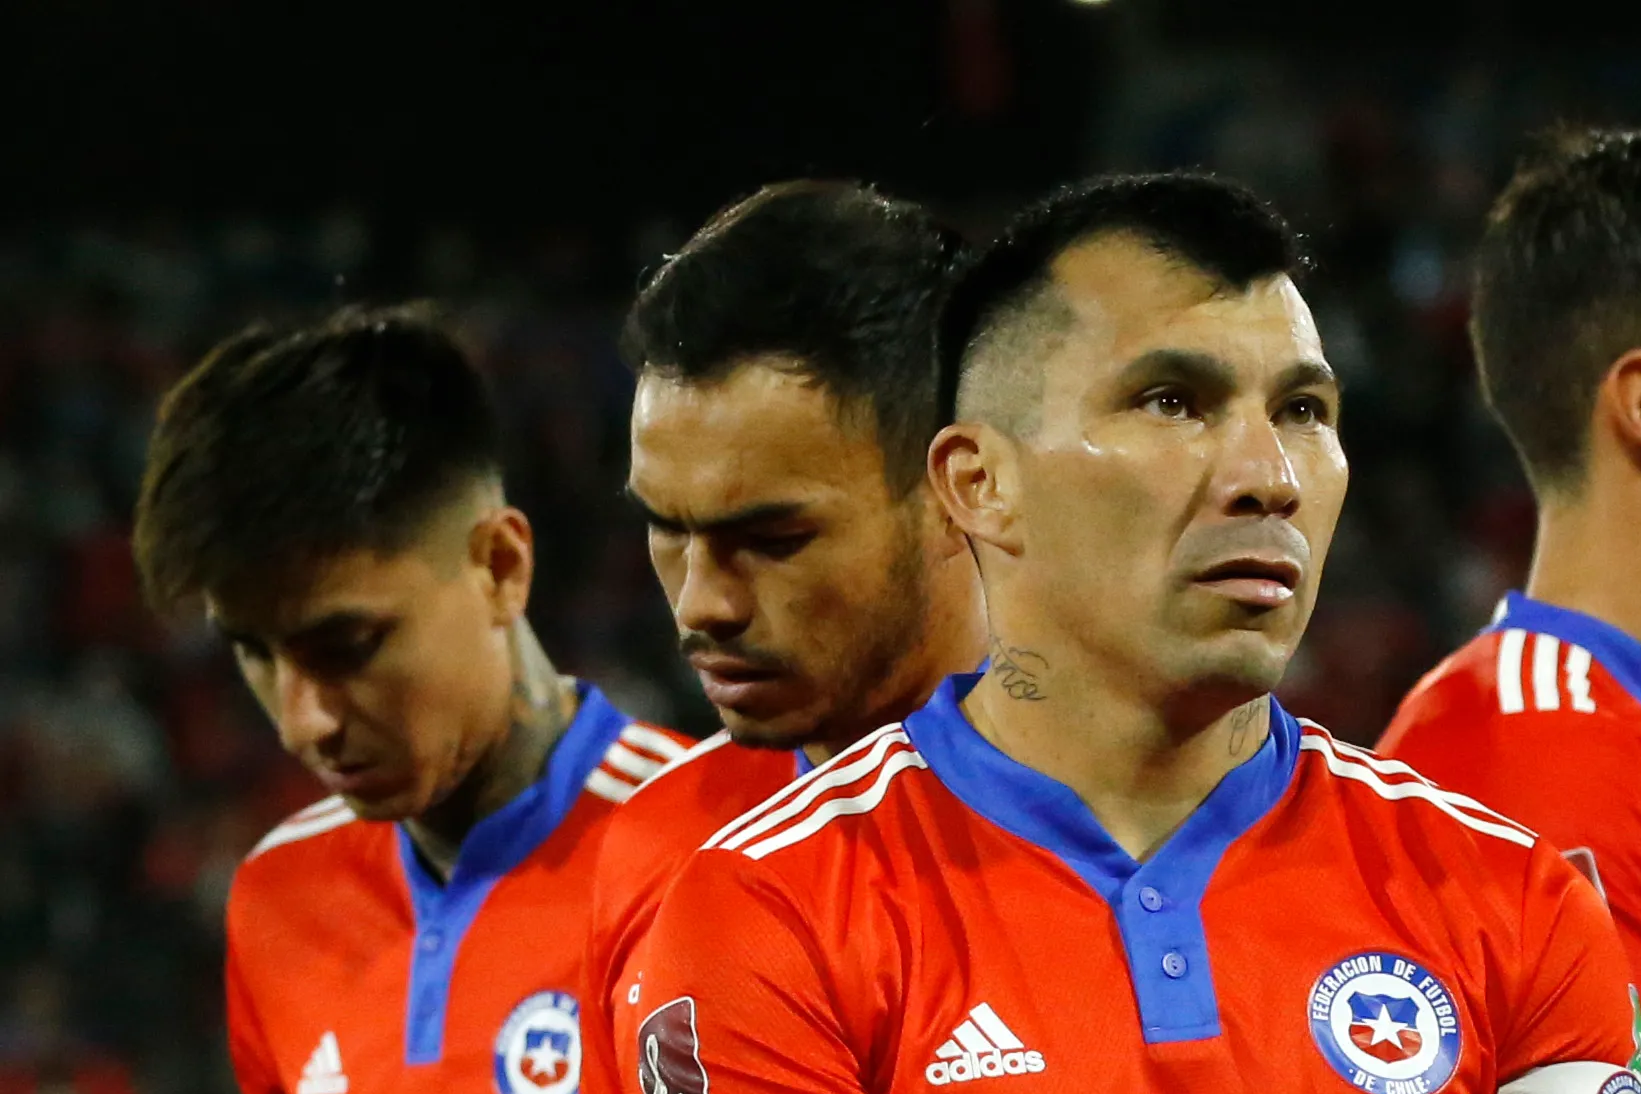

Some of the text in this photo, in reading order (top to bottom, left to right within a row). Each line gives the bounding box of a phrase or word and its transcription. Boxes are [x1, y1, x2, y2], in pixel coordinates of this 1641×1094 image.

[1312, 955, 1457, 1037] FEDERACION DE FUTBOL
[925, 1049, 1046, 1087] adidas
[1353, 1069, 1377, 1091] DE
